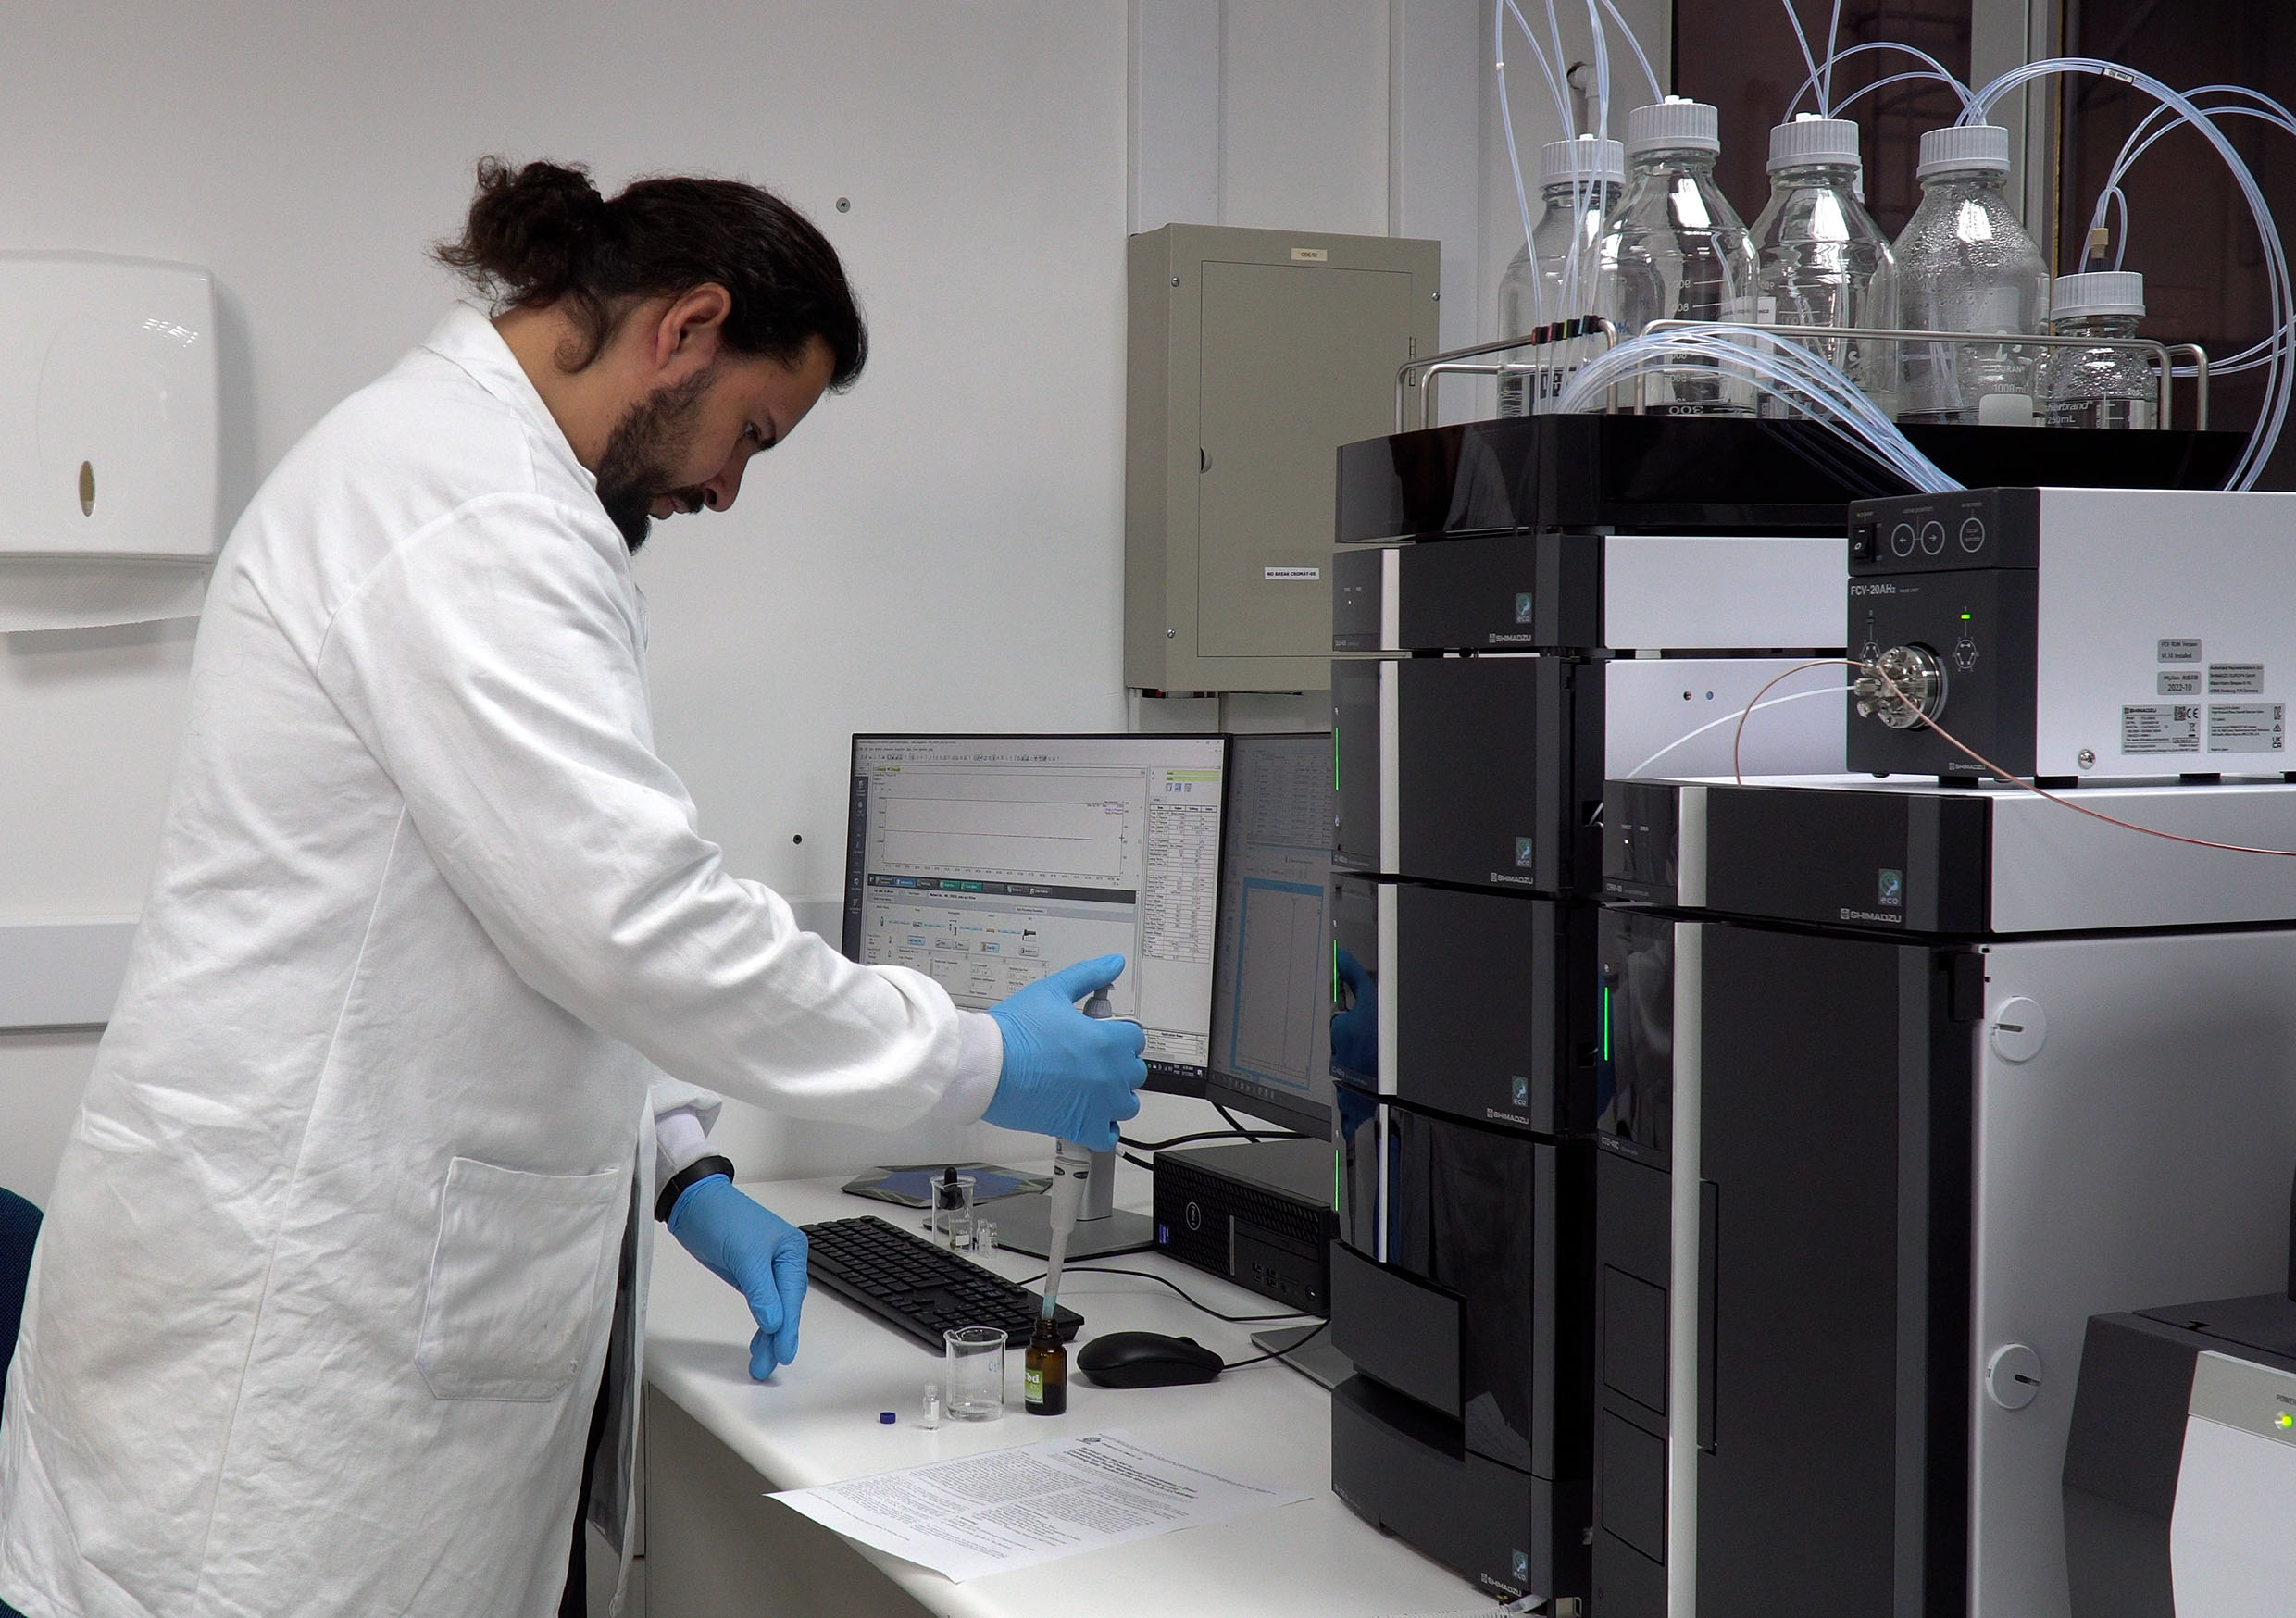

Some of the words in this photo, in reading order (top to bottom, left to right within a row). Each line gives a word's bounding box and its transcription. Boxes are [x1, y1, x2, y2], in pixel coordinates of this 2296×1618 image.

[1497, 874, 1534, 885] SHIMADZU
[1880, 896, 1899, 905] eco
[1850, 910, 1902, 923] SHIMADZU
[1493, 1111, 1529, 1125] SHIMADZU
[1513, 1570, 1527, 1582] eco
[1487, 1576, 1522, 1598] SHIMADZU
